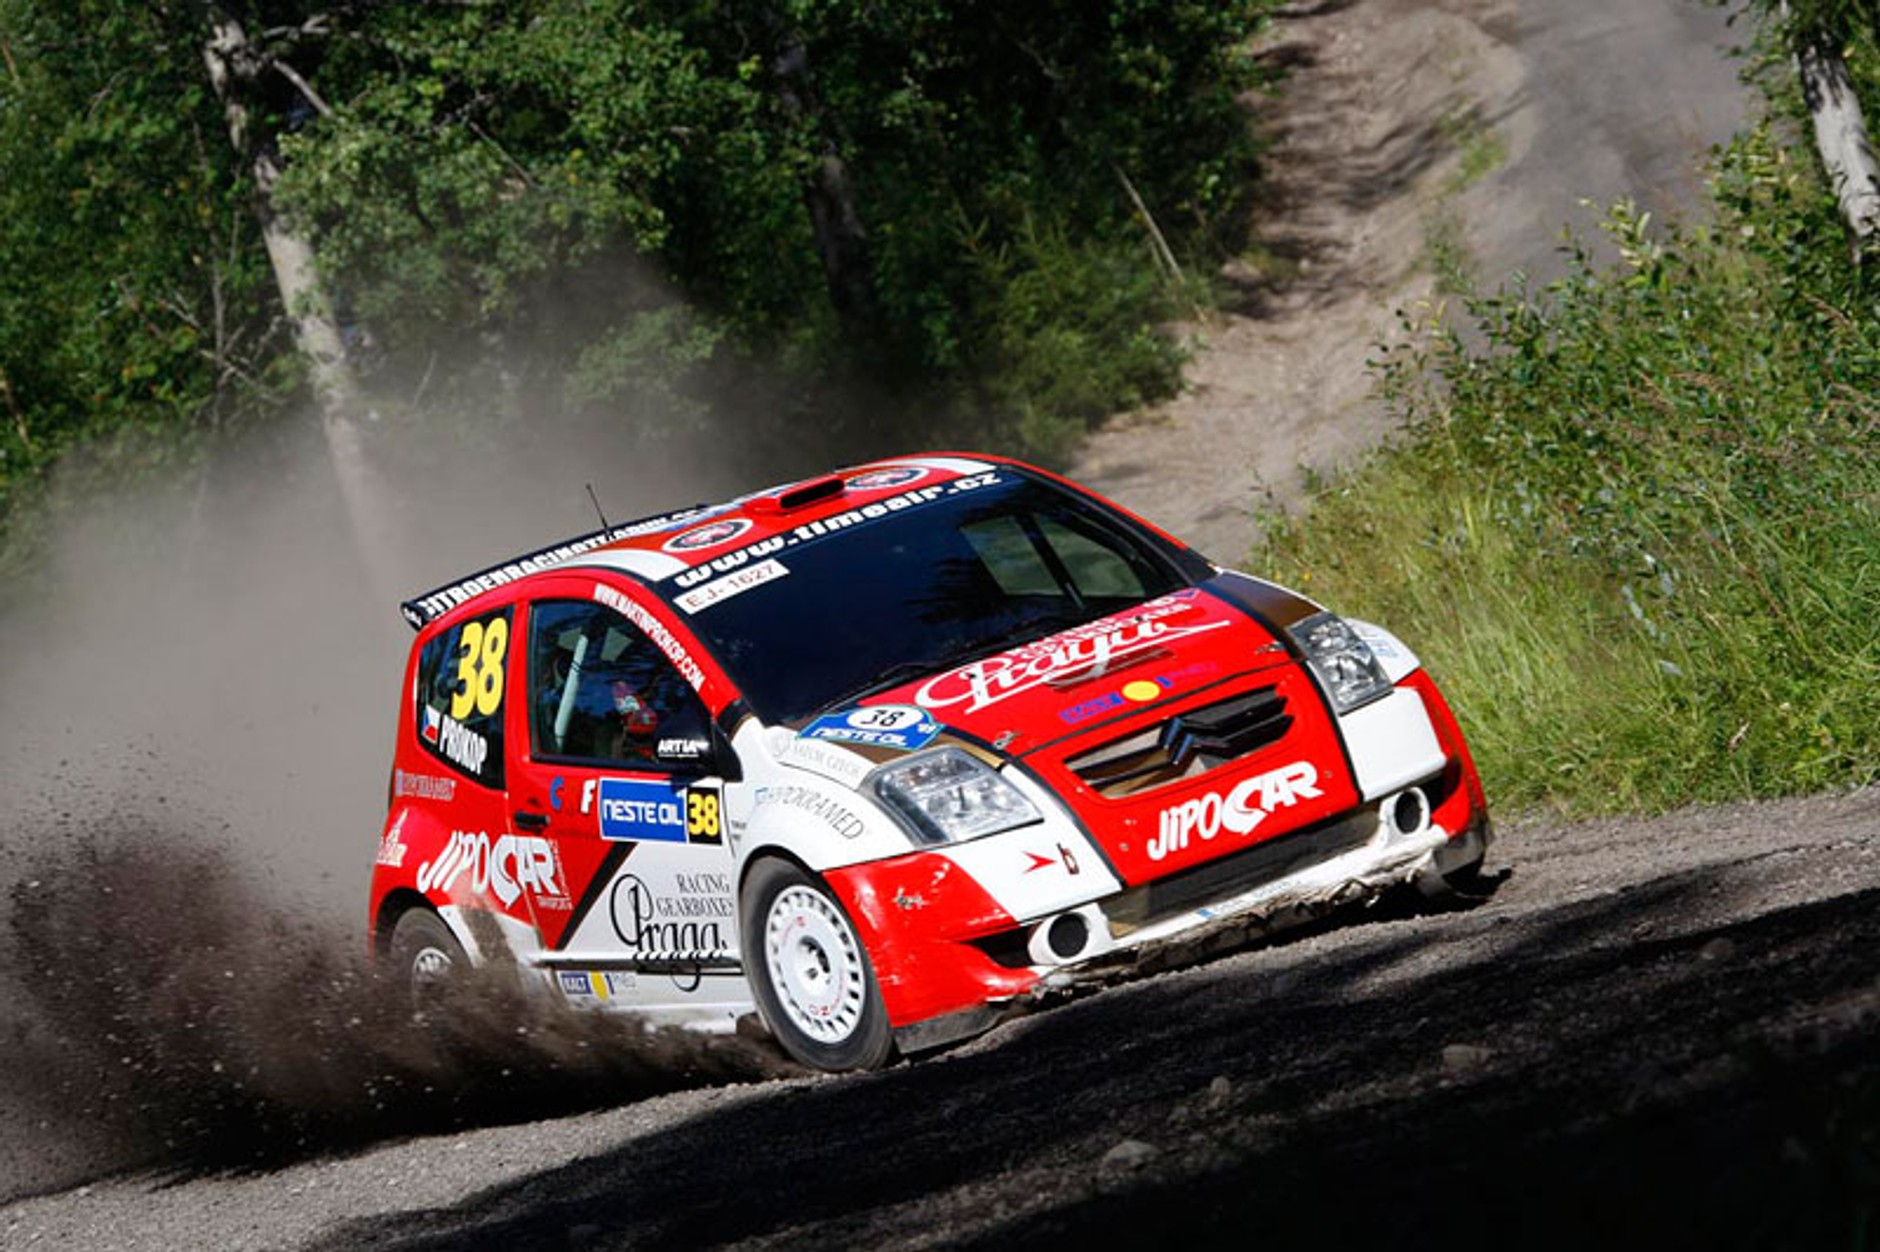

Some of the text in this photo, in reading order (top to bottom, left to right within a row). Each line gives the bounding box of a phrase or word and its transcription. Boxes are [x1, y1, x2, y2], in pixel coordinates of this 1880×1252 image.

[451, 617, 508, 720] 38
[860, 709, 906, 727] 38
[439, 714, 488, 775] PROKOP
[603, 799, 657, 824] NESTE
[687, 793, 719, 837] 38
[1147, 761, 1325, 861] JIPOCAR
[416, 830, 561, 910] JIPOCAR
[676, 874, 731, 893] RACING
